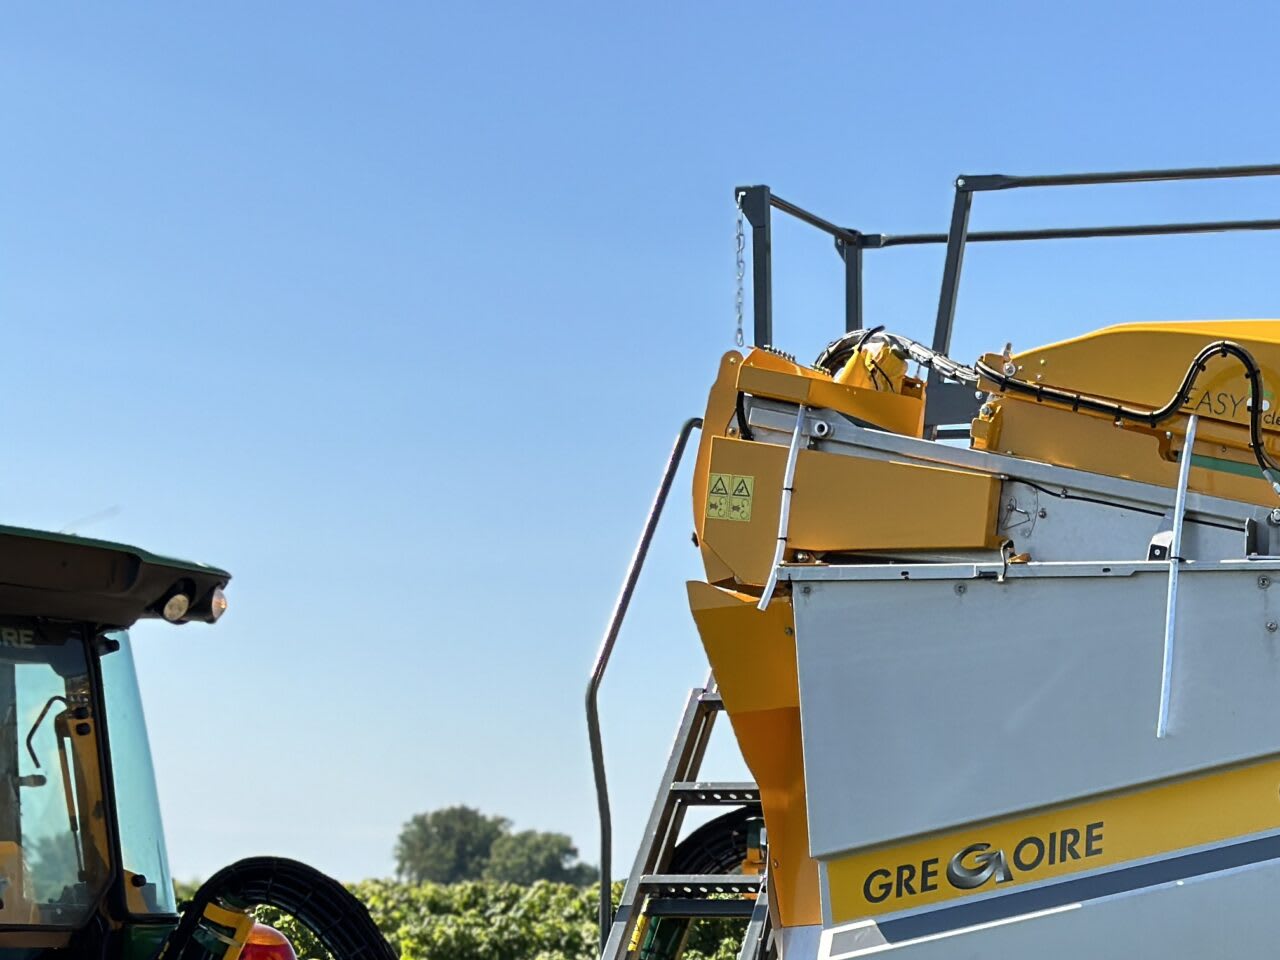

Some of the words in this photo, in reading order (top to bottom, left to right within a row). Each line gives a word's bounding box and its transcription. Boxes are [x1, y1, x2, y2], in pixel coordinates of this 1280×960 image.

[1182, 387, 1246, 418] EASY
[0, 627, 35, 648] RE
[863, 821, 1104, 904] GREGOIRE
